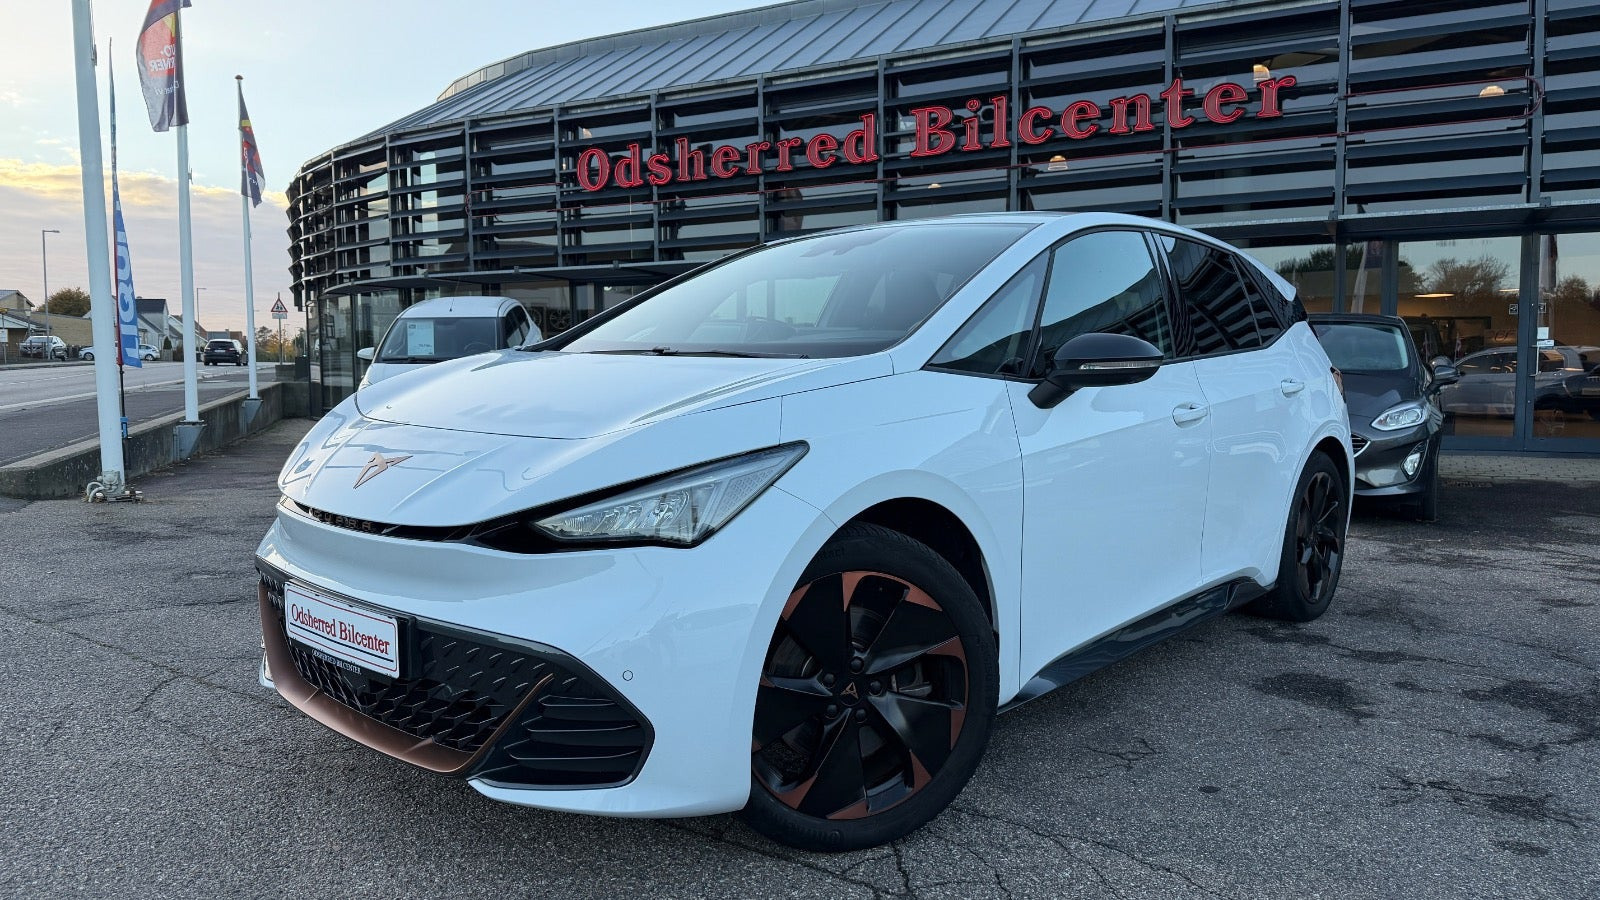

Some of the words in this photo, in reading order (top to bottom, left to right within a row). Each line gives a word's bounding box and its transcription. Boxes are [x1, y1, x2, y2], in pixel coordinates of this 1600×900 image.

[577, 113, 879, 192] Odsherred
[909, 75, 1297, 158] Bilcenter
[291, 604, 336, 637] Odsherred
[338, 621, 390, 655] Bilcenter
